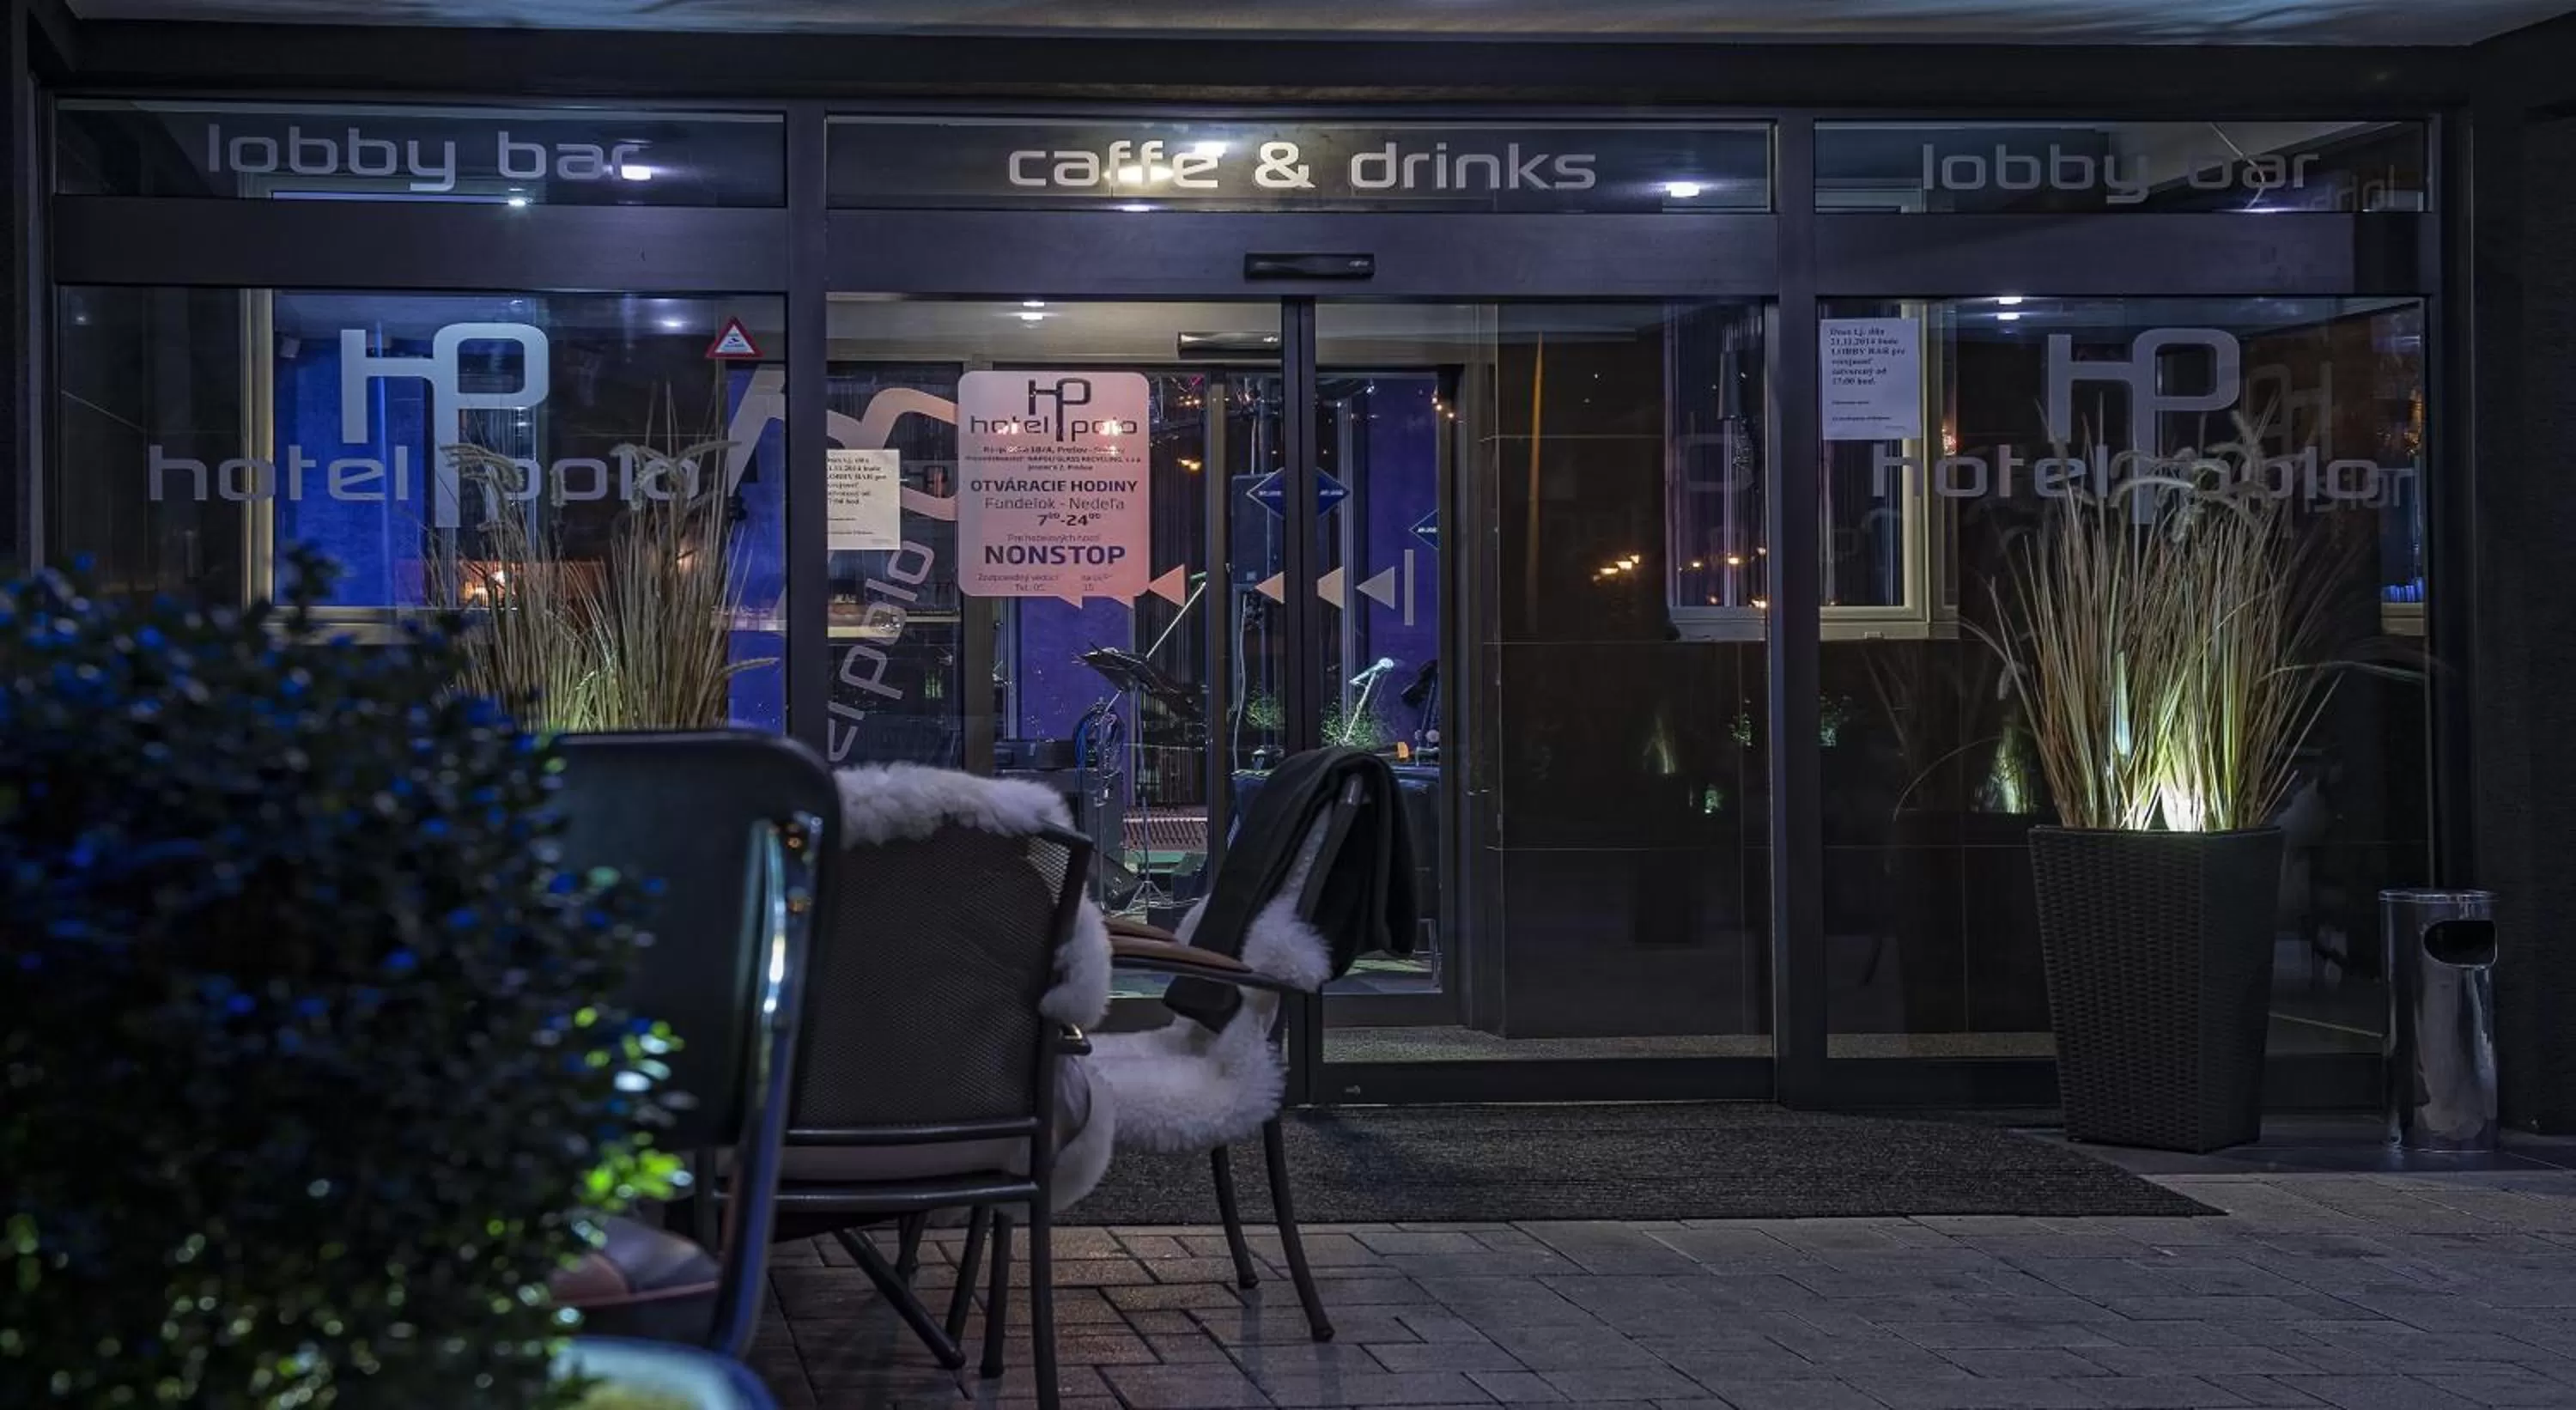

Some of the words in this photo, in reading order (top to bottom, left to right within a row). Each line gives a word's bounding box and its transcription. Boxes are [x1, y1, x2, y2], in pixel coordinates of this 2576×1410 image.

[209, 125, 456, 191] lobby
[498, 131, 641, 182] bar
[1008, 140, 1219, 188] caffe
[1255, 141, 1315, 189] &
[1350, 143, 1597, 191] drinks
[1923, 143, 2147, 204] lobby
[970, 415, 1049, 435] hotel
[148, 445, 410, 501] hotel
[970, 477, 1066, 492] OTVÁRACIE
[1071, 480, 1139, 492] HODINY
[1871, 444, 2109, 499] hotel
[984, 545, 1126, 565] NONSTOP
